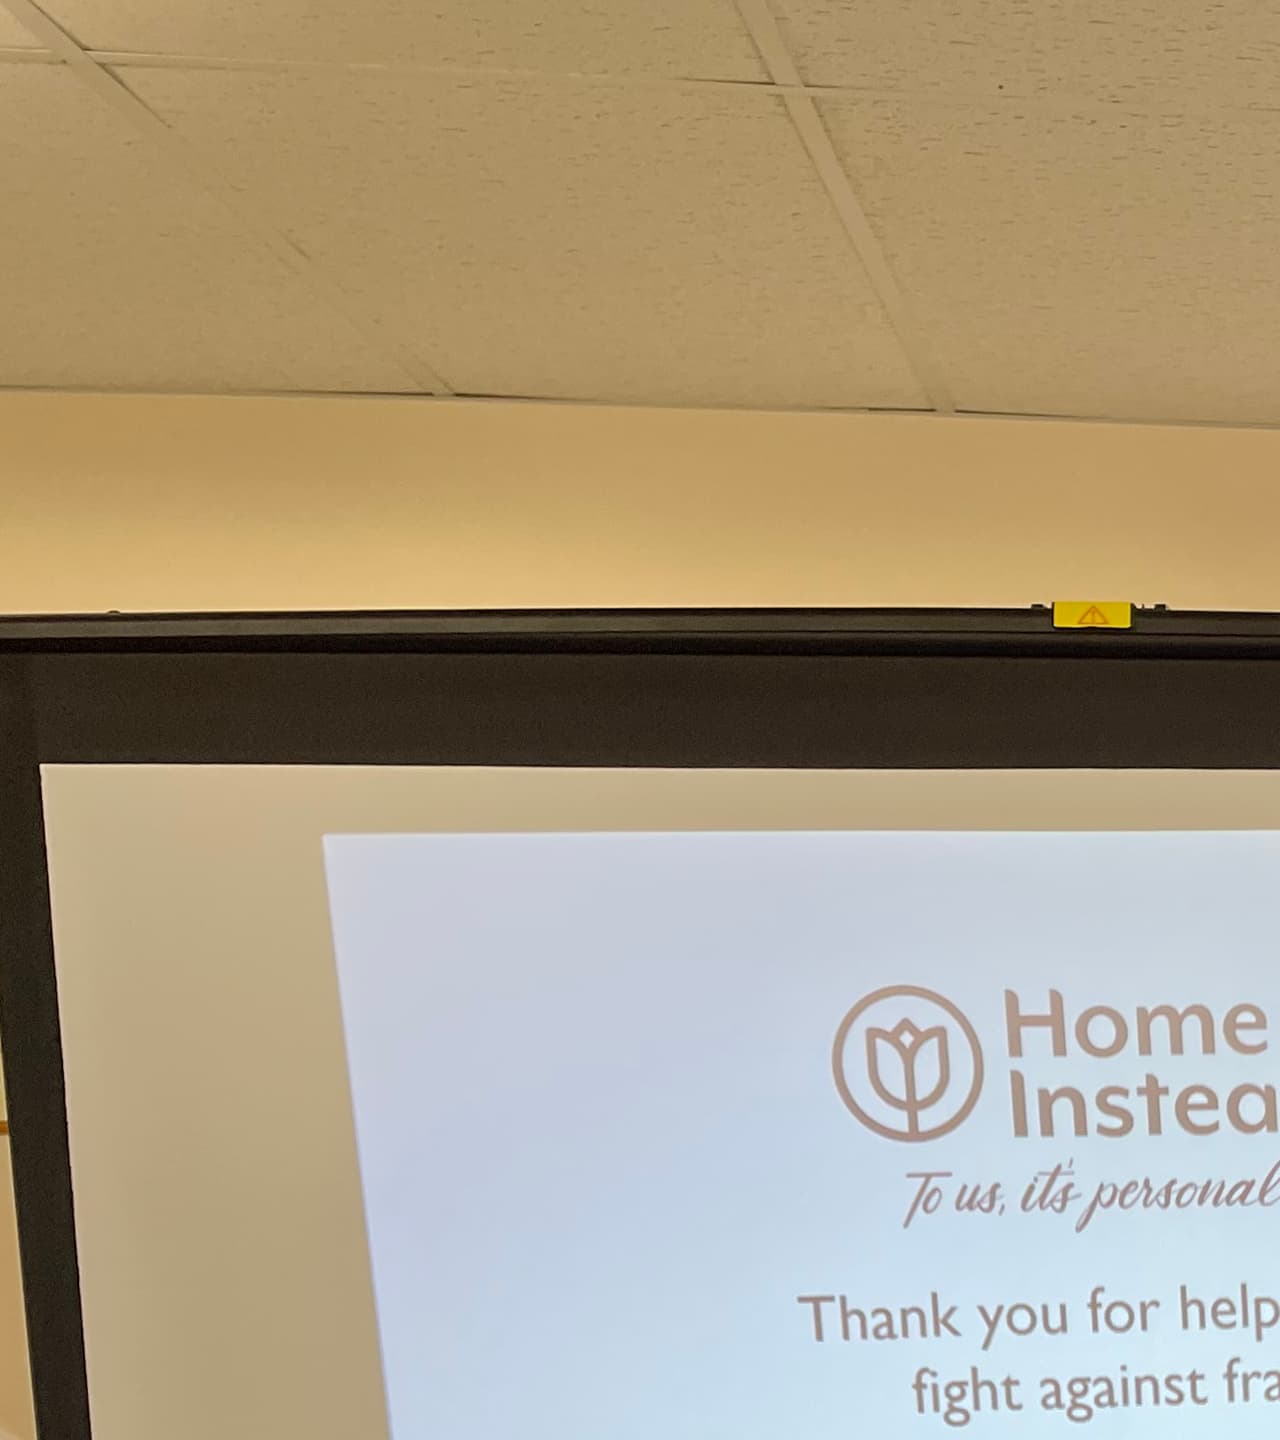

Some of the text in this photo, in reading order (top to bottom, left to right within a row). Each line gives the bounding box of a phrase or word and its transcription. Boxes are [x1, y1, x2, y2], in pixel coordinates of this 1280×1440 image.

[1004, 989, 1269, 1058] Home
[903, 1171, 953, 1229] To
[955, 1178, 1007, 1215] us,
[1021, 1157, 1081, 1213] it's
[797, 1291, 962, 1342] Thank
[981, 1301, 1068, 1350] you
[1087, 1286, 1160, 1334] for
[912, 1366, 1023, 1427] fight
[1040, 1365, 1206, 1422] against
